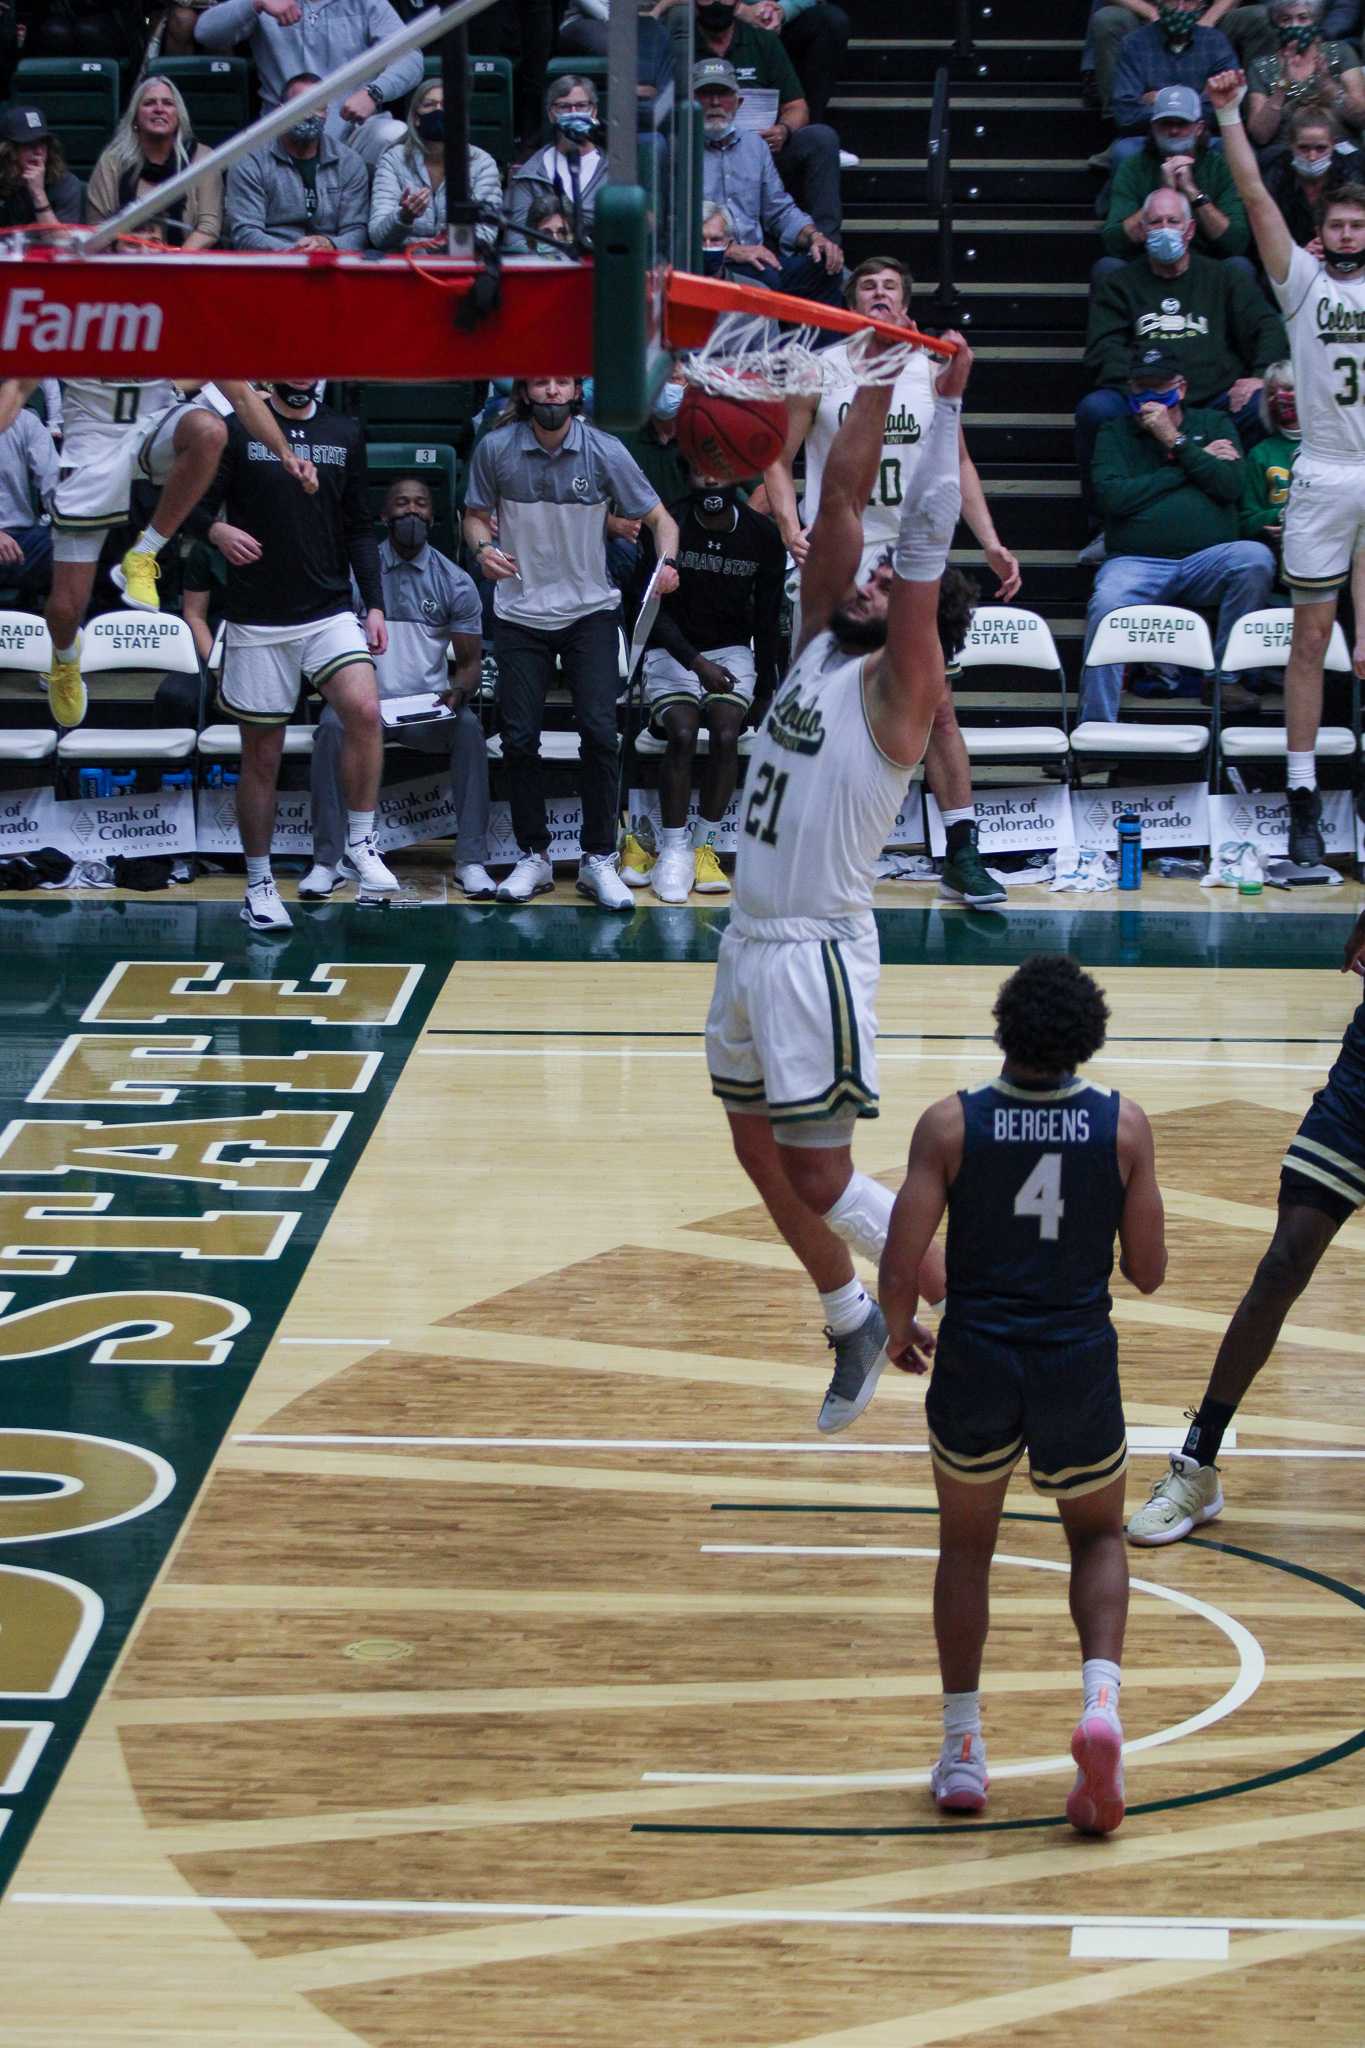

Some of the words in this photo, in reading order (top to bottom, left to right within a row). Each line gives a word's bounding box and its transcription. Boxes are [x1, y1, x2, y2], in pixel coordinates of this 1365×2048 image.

[2, 288, 163, 352] Farm
[1334, 357, 1365, 405] 3
[113, 387, 141, 424] 0
[312, 445, 347, 467] STATE
[422, 450, 430, 462] 3
[867, 458, 903, 506] 0
[94, 624, 180, 636] COLORADO
[968, 619, 1038, 631] LORADO
[1109, 617, 1195, 631] COLORADO
[1244, 622, 1294, 635] COLOR
[112, 637, 161, 649] STATE
[971, 632, 1019, 645] STATE
[1128, 631, 1176, 643] STATE
[1263, 635, 1292, 648] STA
[379, 791, 421, 815] Bank
[425, 785, 440, 803] of
[745, 761, 790, 846] 21
[974, 799, 1016, 817] Bank
[1020, 798, 1038, 813] of
[1111, 797, 1154, 815] Bank
[1158, 796, 1176, 811] of
[96, 806, 139, 824] Bank
[143, 804, 161, 820] of
[563, 808, 581, 823] of
[1112, 812, 1191, 830] Corado
[1255, 804, 1292, 820] Ban
[98, 820, 178, 841] Colorado
[977, 813, 1055, 834] Colorado
[1257, 818, 1336, 836] Coldo
[994, 1108, 1090, 1142] BERGENS
[1013, 1152, 1065, 1240] 4
